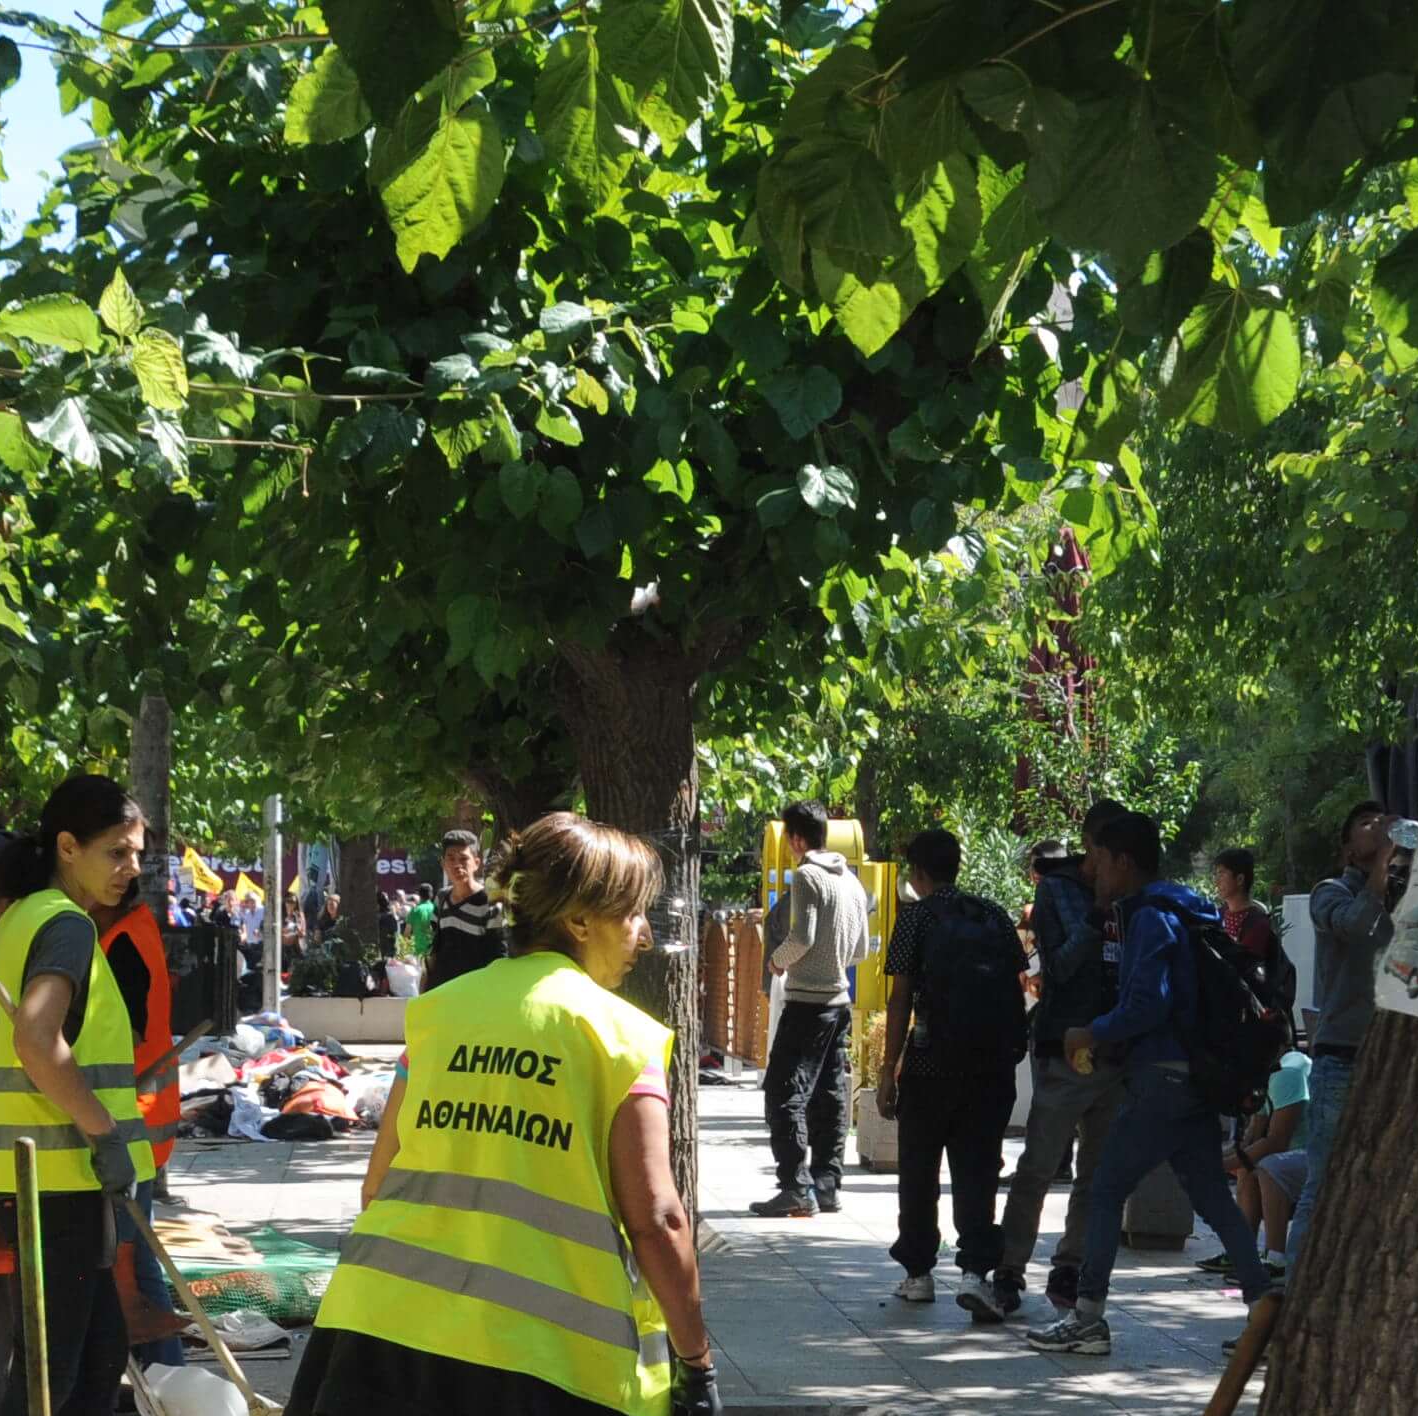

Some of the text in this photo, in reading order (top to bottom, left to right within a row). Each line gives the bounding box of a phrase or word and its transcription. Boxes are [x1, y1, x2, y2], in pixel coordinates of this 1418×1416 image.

[376, 854, 417, 874] est
[447, 1044, 562, 1087] ΔΗΜΟΣ
[416, 1099, 574, 1152] ΑΘΗΝΑΙΩΝ
